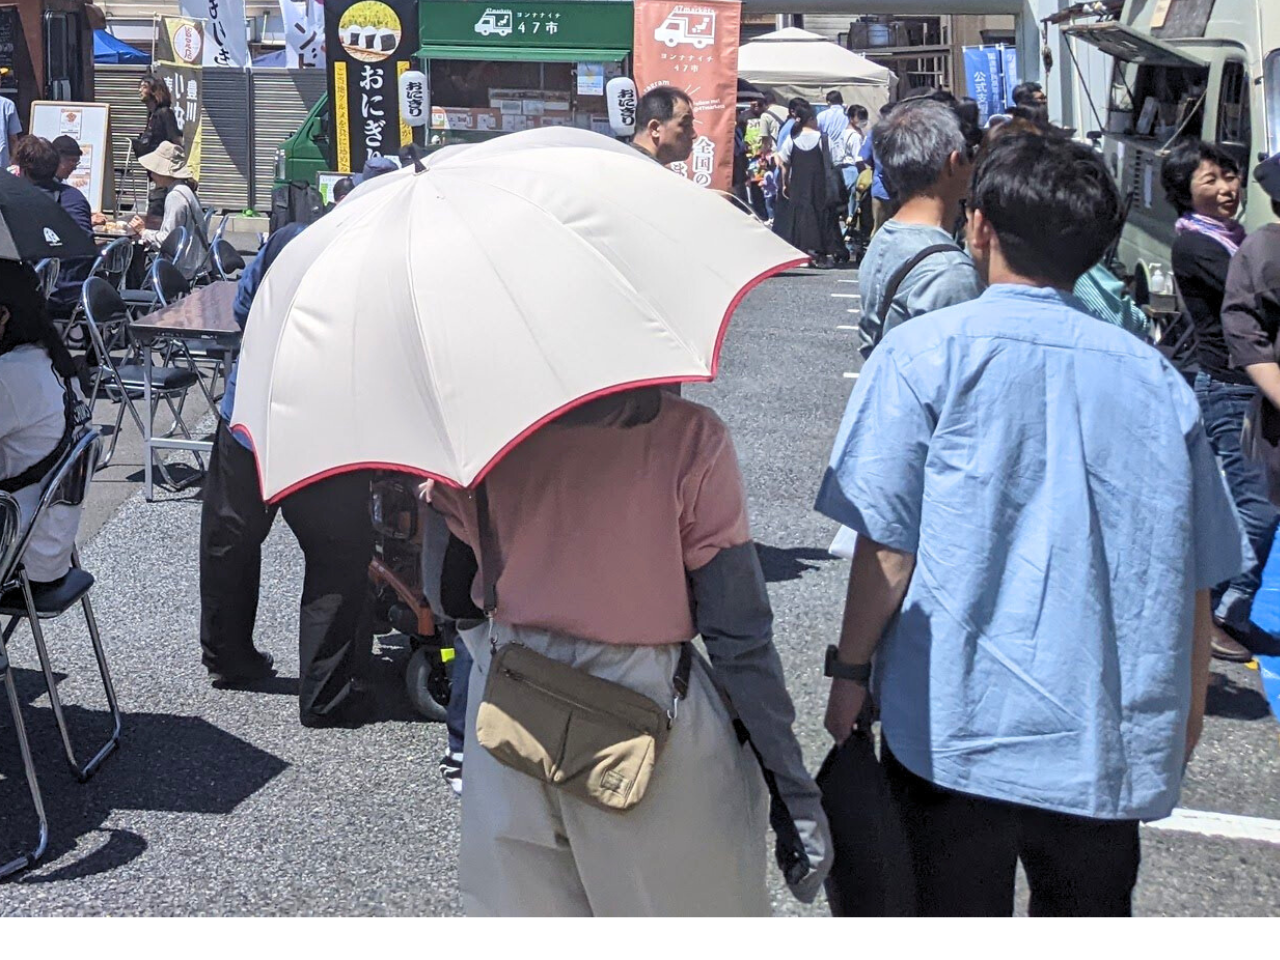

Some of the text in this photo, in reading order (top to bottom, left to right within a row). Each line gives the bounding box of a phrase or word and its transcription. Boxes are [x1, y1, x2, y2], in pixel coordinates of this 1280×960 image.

[661, 53, 714, 62] ヨンナナイチ
[694, 137, 713, 187] 全国の
